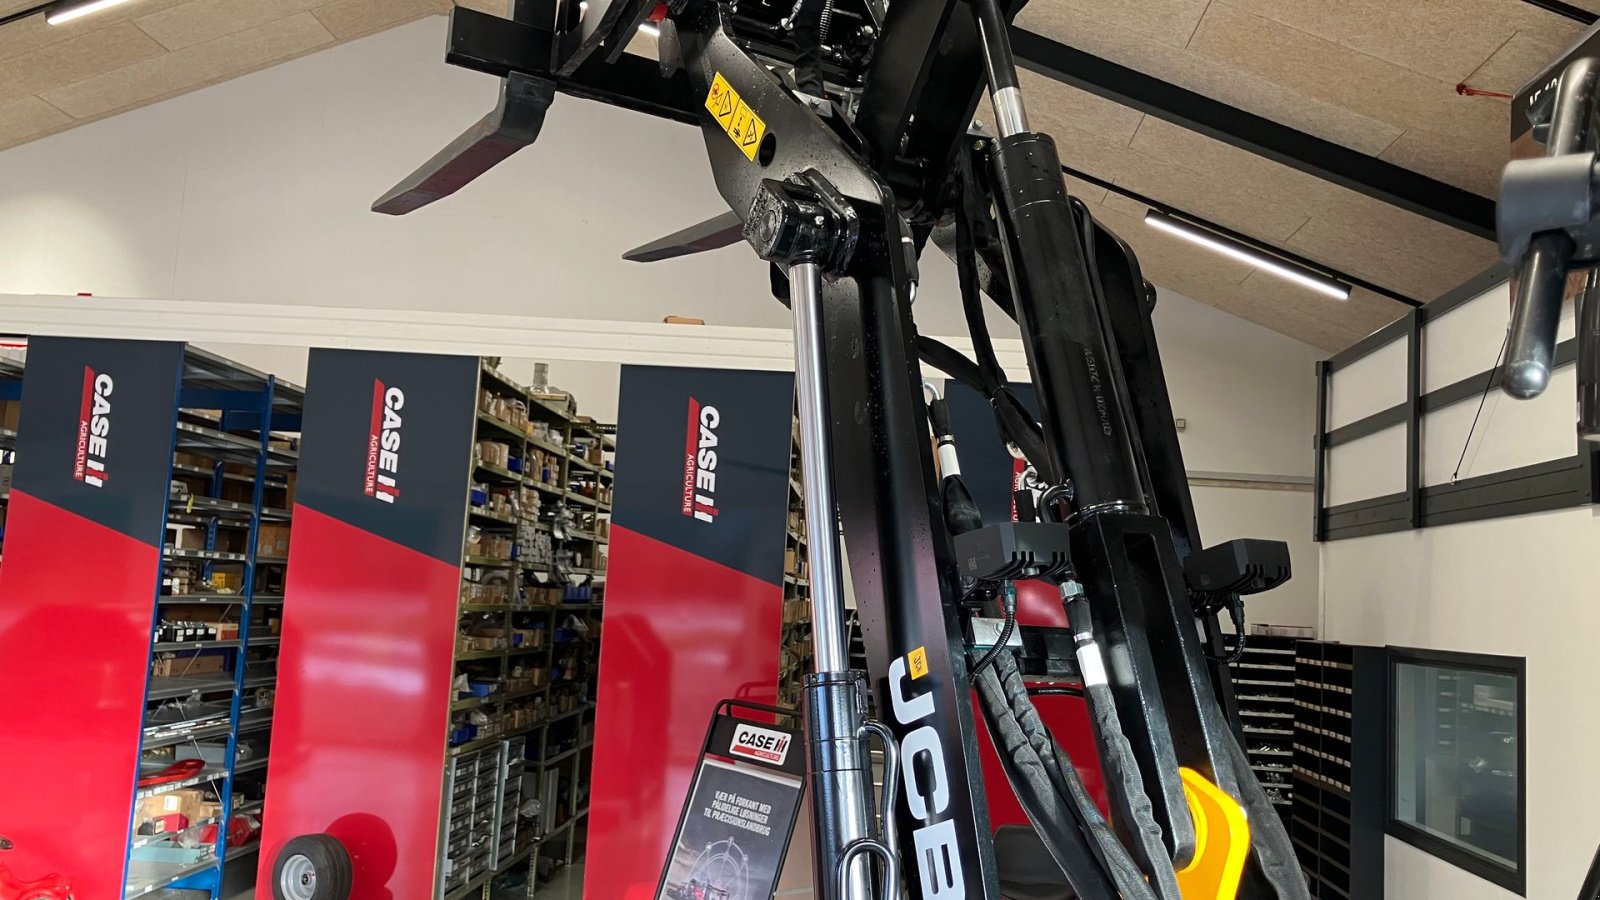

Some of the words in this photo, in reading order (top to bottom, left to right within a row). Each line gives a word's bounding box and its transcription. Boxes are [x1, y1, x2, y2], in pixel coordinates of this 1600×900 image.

[88, 373, 113, 458] CASE
[379, 387, 405, 473] CASE
[75, 420, 88, 477] AGRICULTURE
[365, 434, 378, 493] AGRICULTURE
[696, 405, 720, 493] CASE
[683, 453, 695, 513] AGRICULTURE
[738, 731, 775, 750] CASE
[736, 795, 759, 809] FORKANT
[759, 803, 772, 815] MED
[889, 656, 965, 900] JCB
[703, 807, 711, 818] TIL
